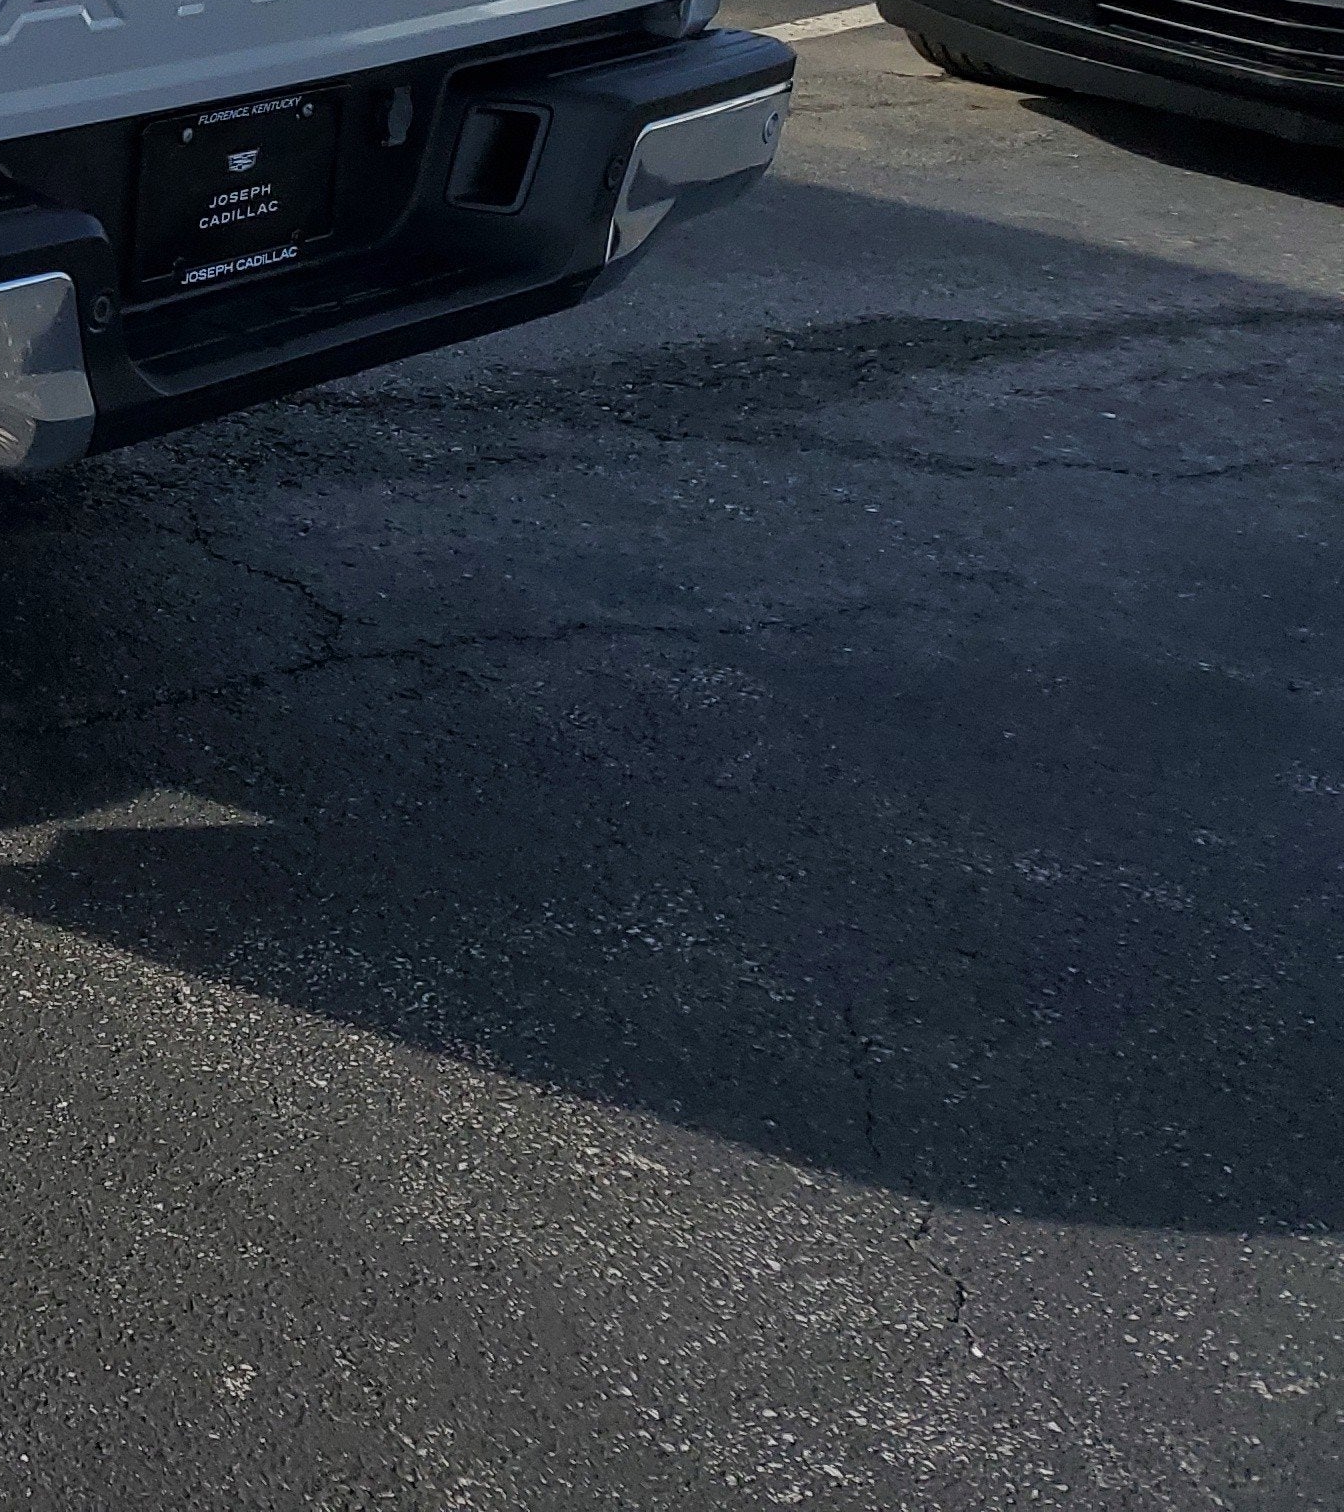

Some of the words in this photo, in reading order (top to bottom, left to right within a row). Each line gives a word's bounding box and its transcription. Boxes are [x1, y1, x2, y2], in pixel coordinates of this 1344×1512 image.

[252, 95, 303, 116] KENTUCKY
[209, 184, 272, 209] JOSEPH
[199, 201, 279, 229] CADILLAC
[181, 262, 234, 285] JOSEPH
[236, 246, 299, 271] CADILLAC
